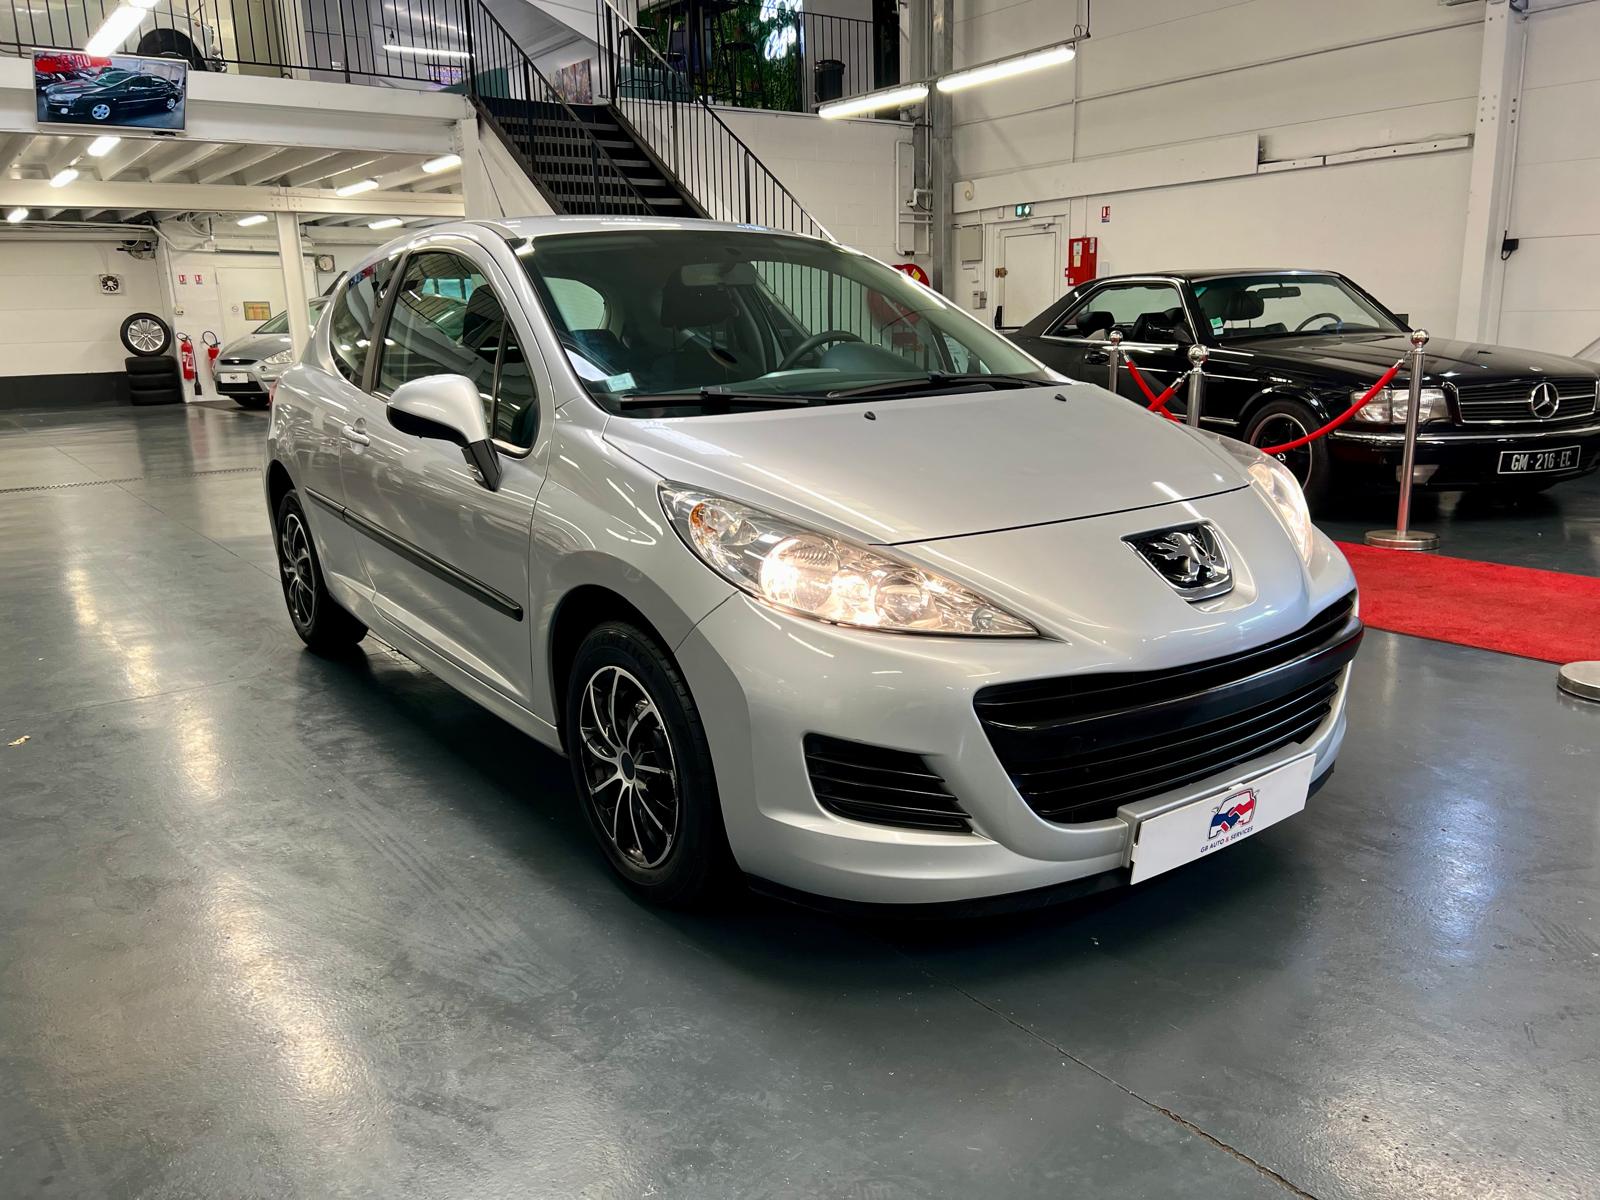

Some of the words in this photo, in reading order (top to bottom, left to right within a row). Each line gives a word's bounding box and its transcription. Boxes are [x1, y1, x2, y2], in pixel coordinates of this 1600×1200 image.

[1200, 845, 1209, 853] GB
[1209, 838, 1225, 849] AUTO
[1230, 825, 1254, 840] SERVICES
